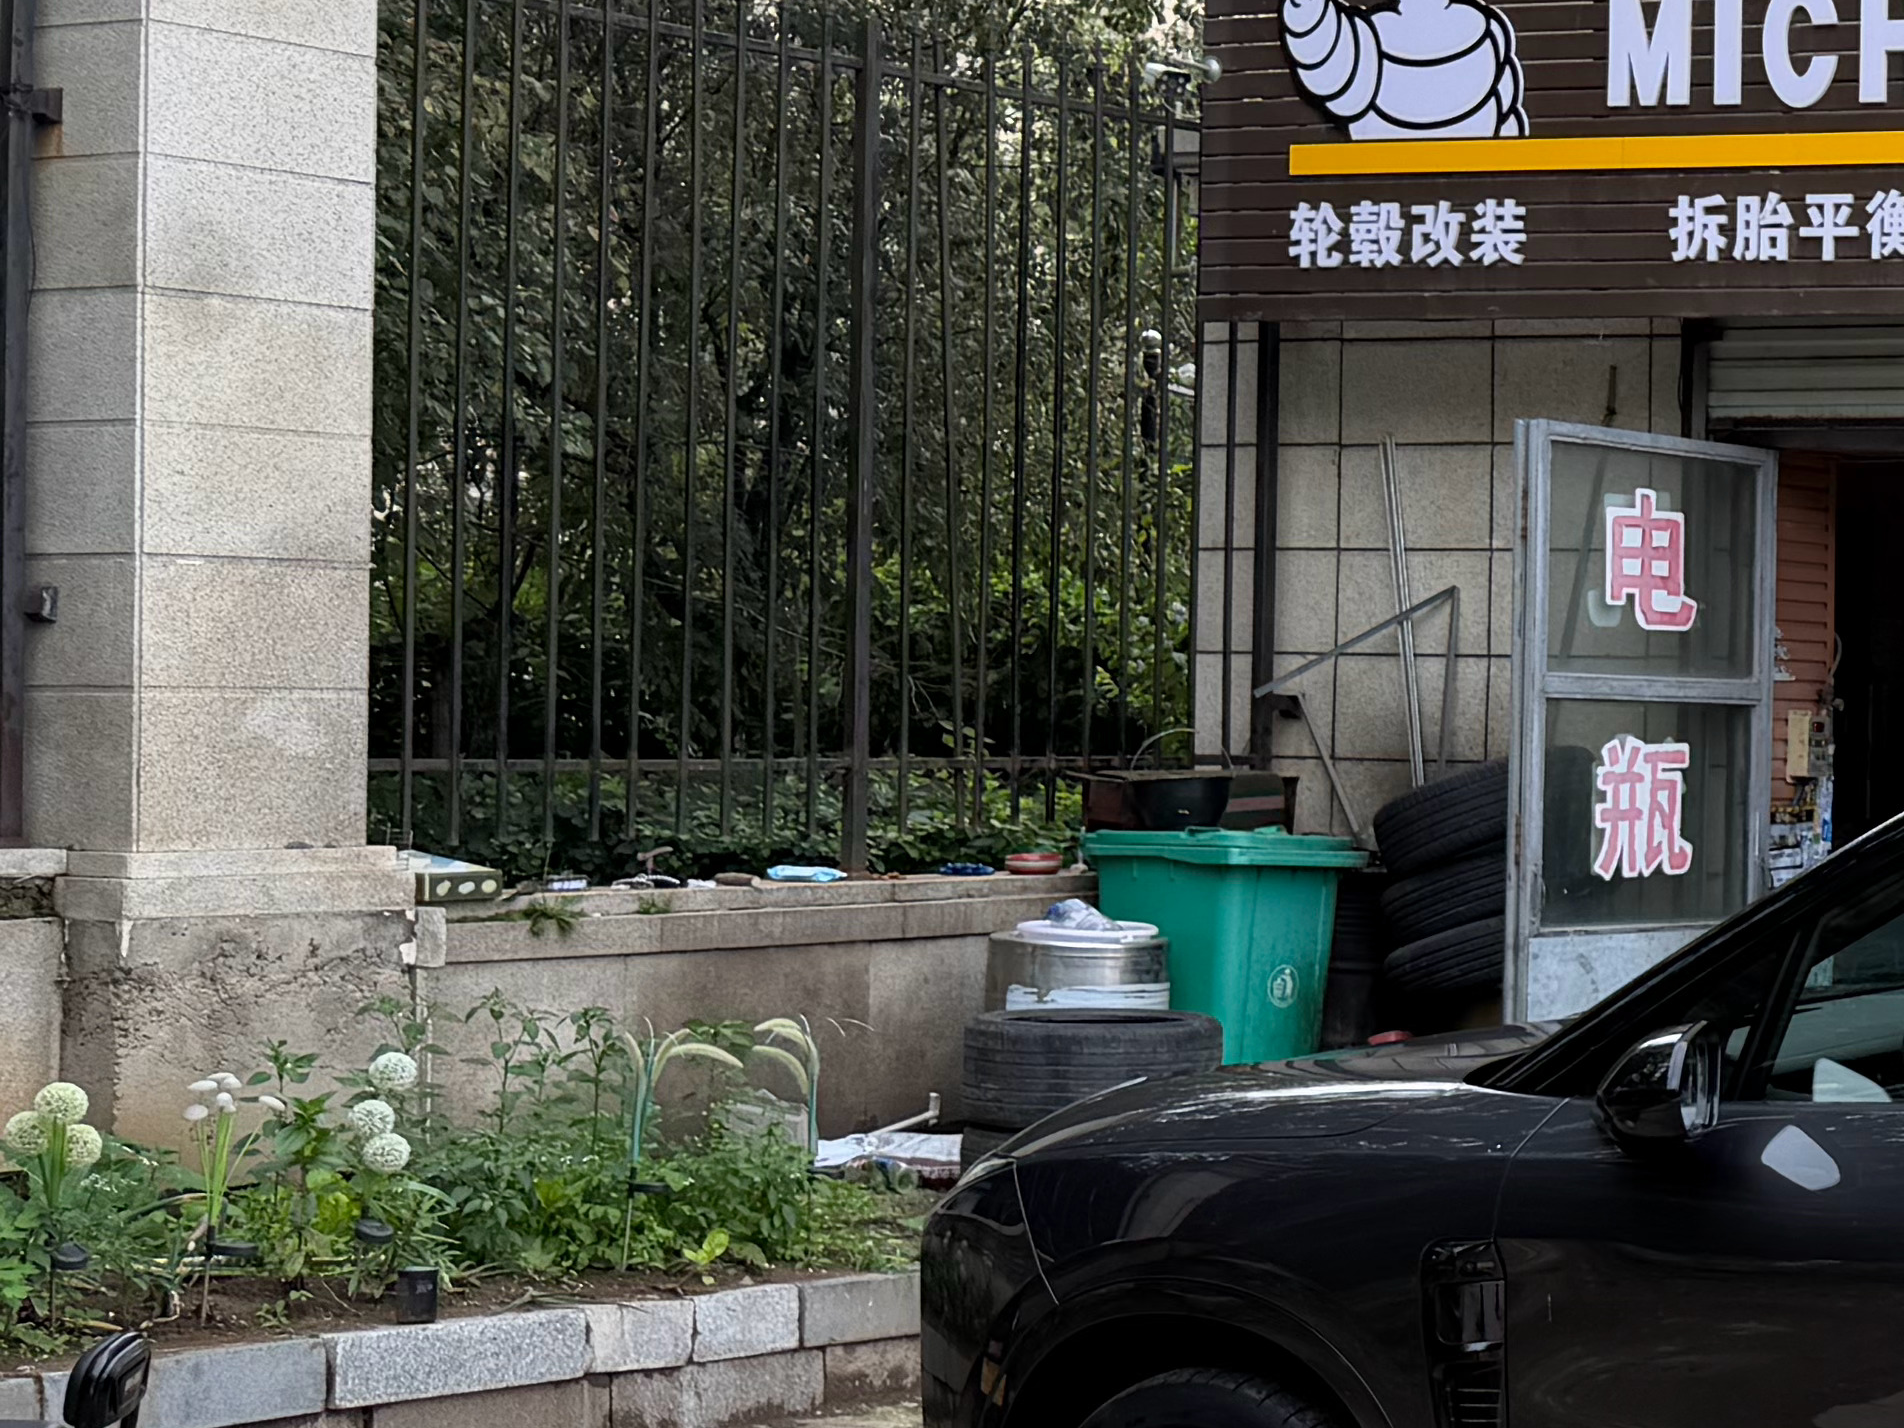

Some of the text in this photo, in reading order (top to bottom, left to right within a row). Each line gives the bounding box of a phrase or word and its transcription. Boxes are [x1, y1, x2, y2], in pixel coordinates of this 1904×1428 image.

[1288, 198, 1527, 269] 轮毂改装
[1594, 488, 1697, 881] 电瓶
